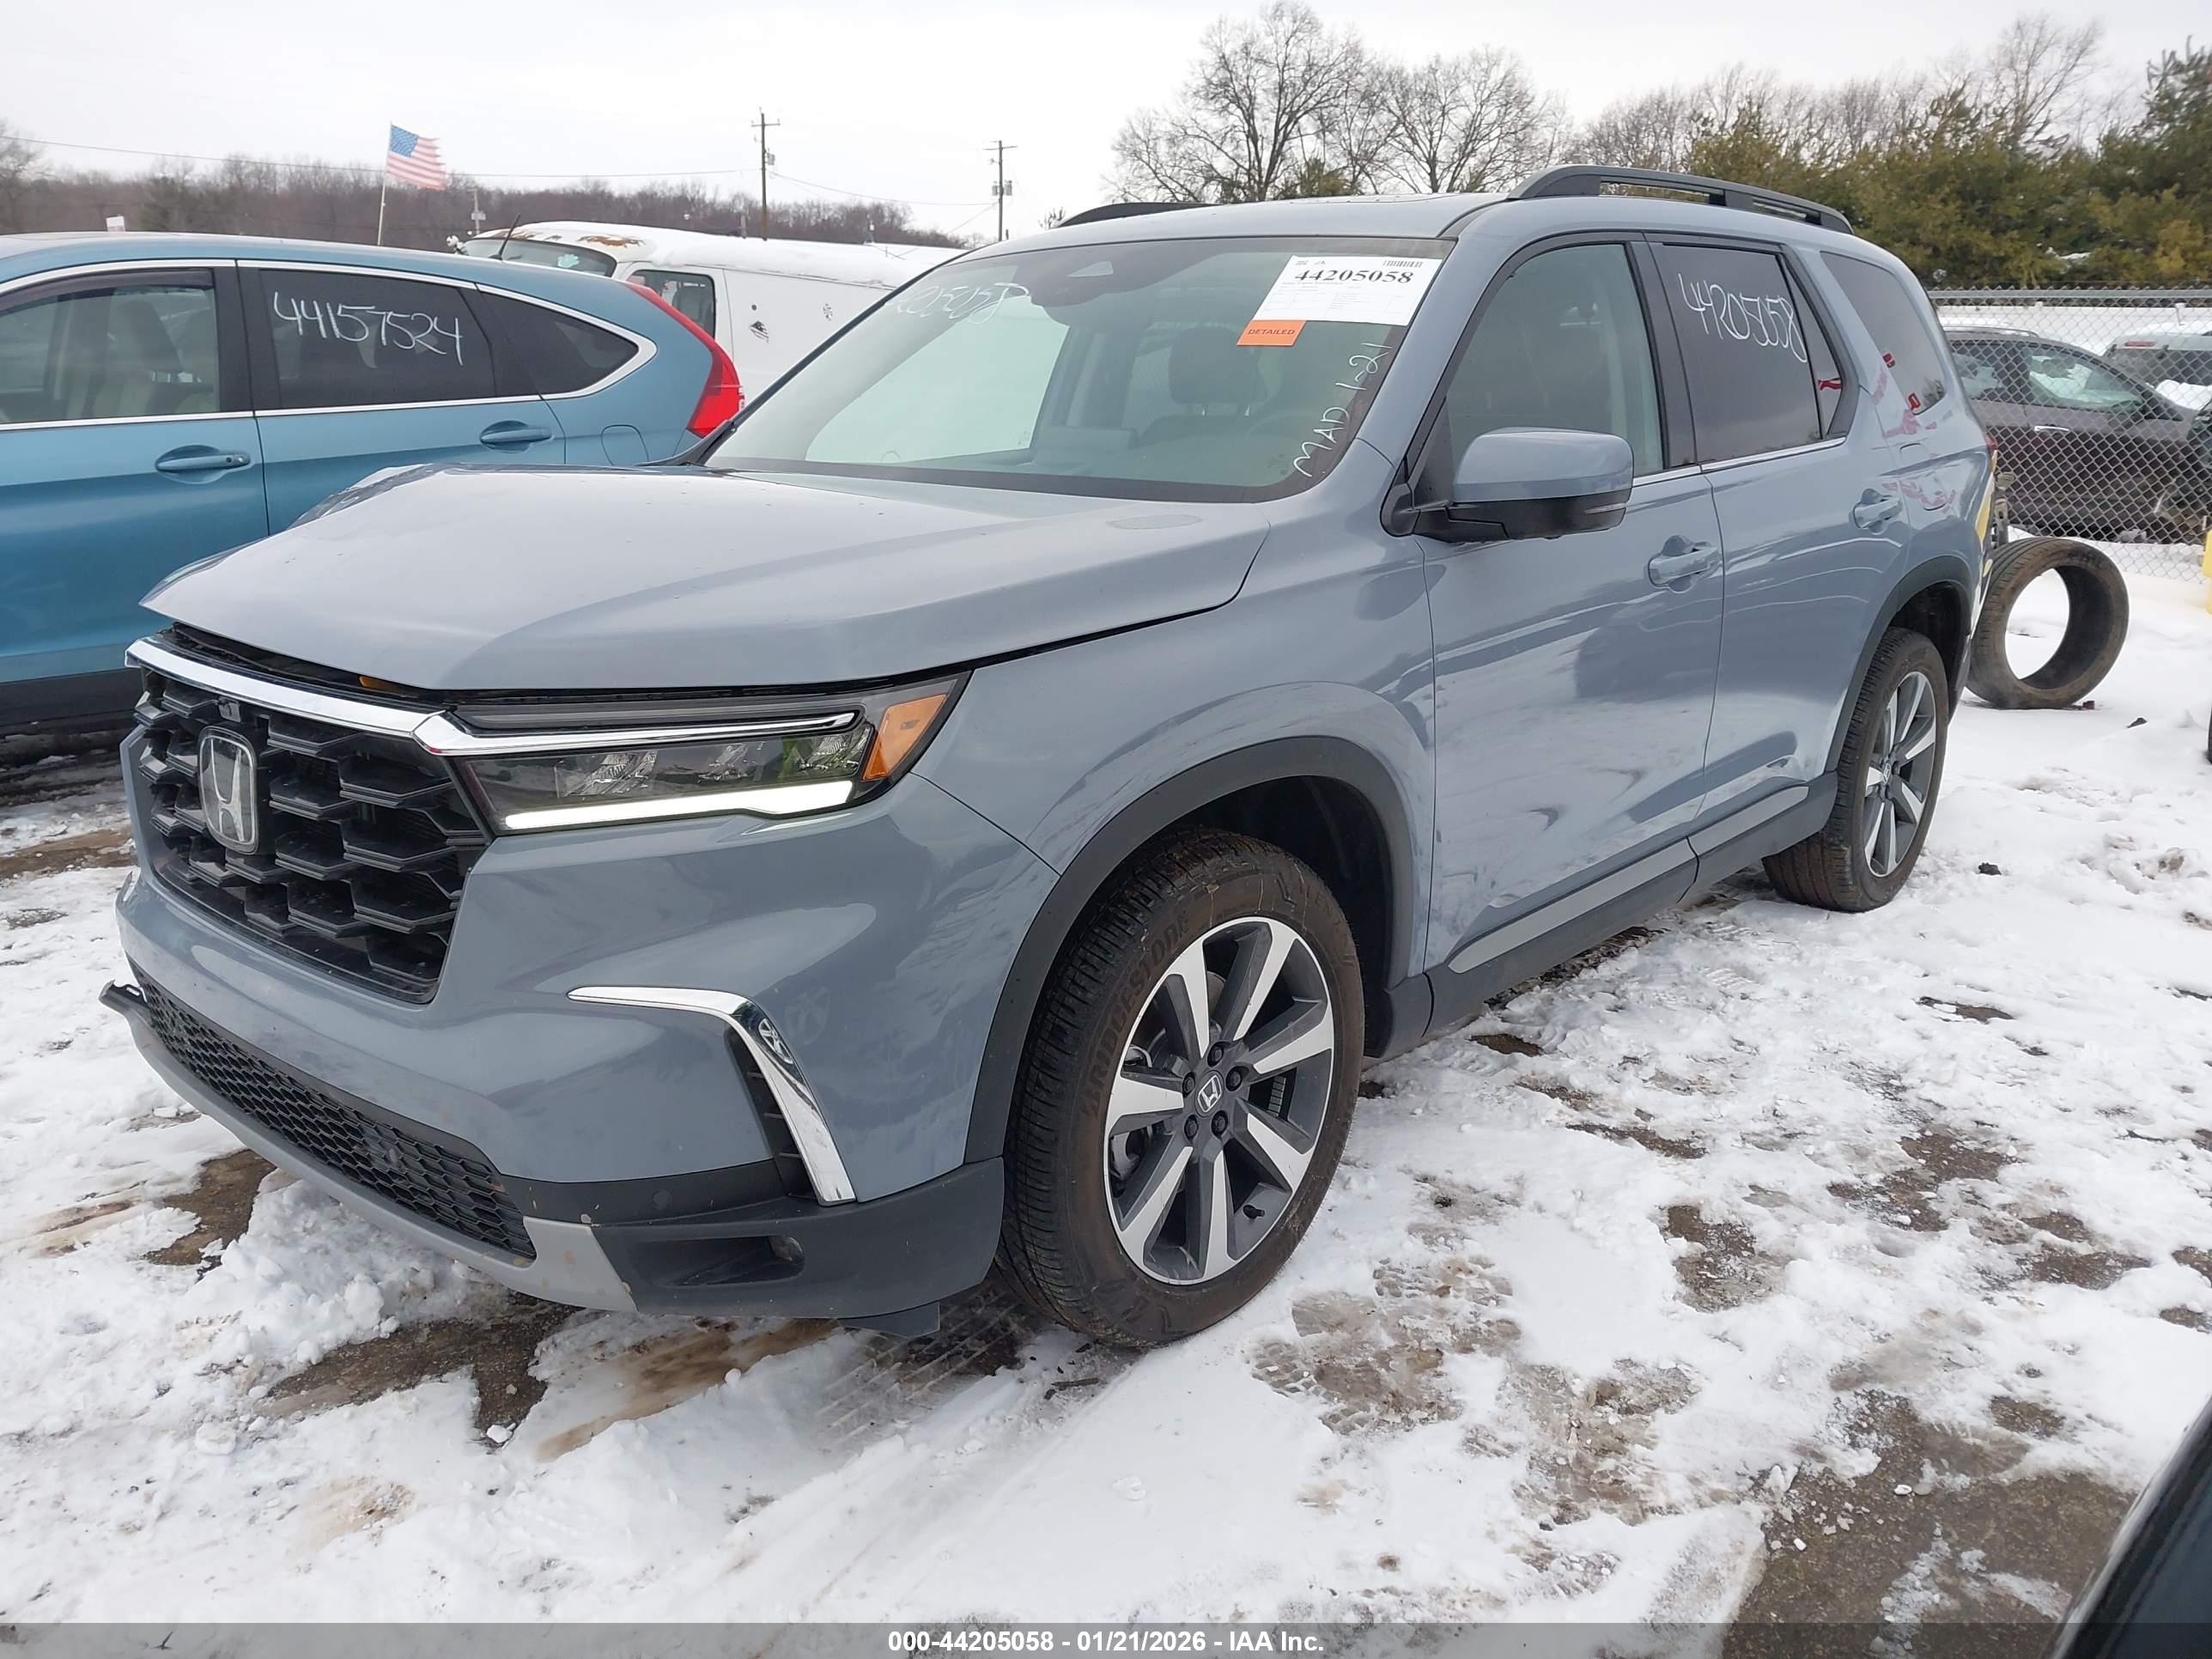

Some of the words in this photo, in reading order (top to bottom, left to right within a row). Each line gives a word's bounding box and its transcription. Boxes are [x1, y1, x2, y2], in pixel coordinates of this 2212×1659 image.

[1295, 270, 1413, 283] 44205058
[273, 291, 464, 366] 44157524
[1293, 406, 1351, 477] MAD
[1335, 343, 1394, 391] 1-21
